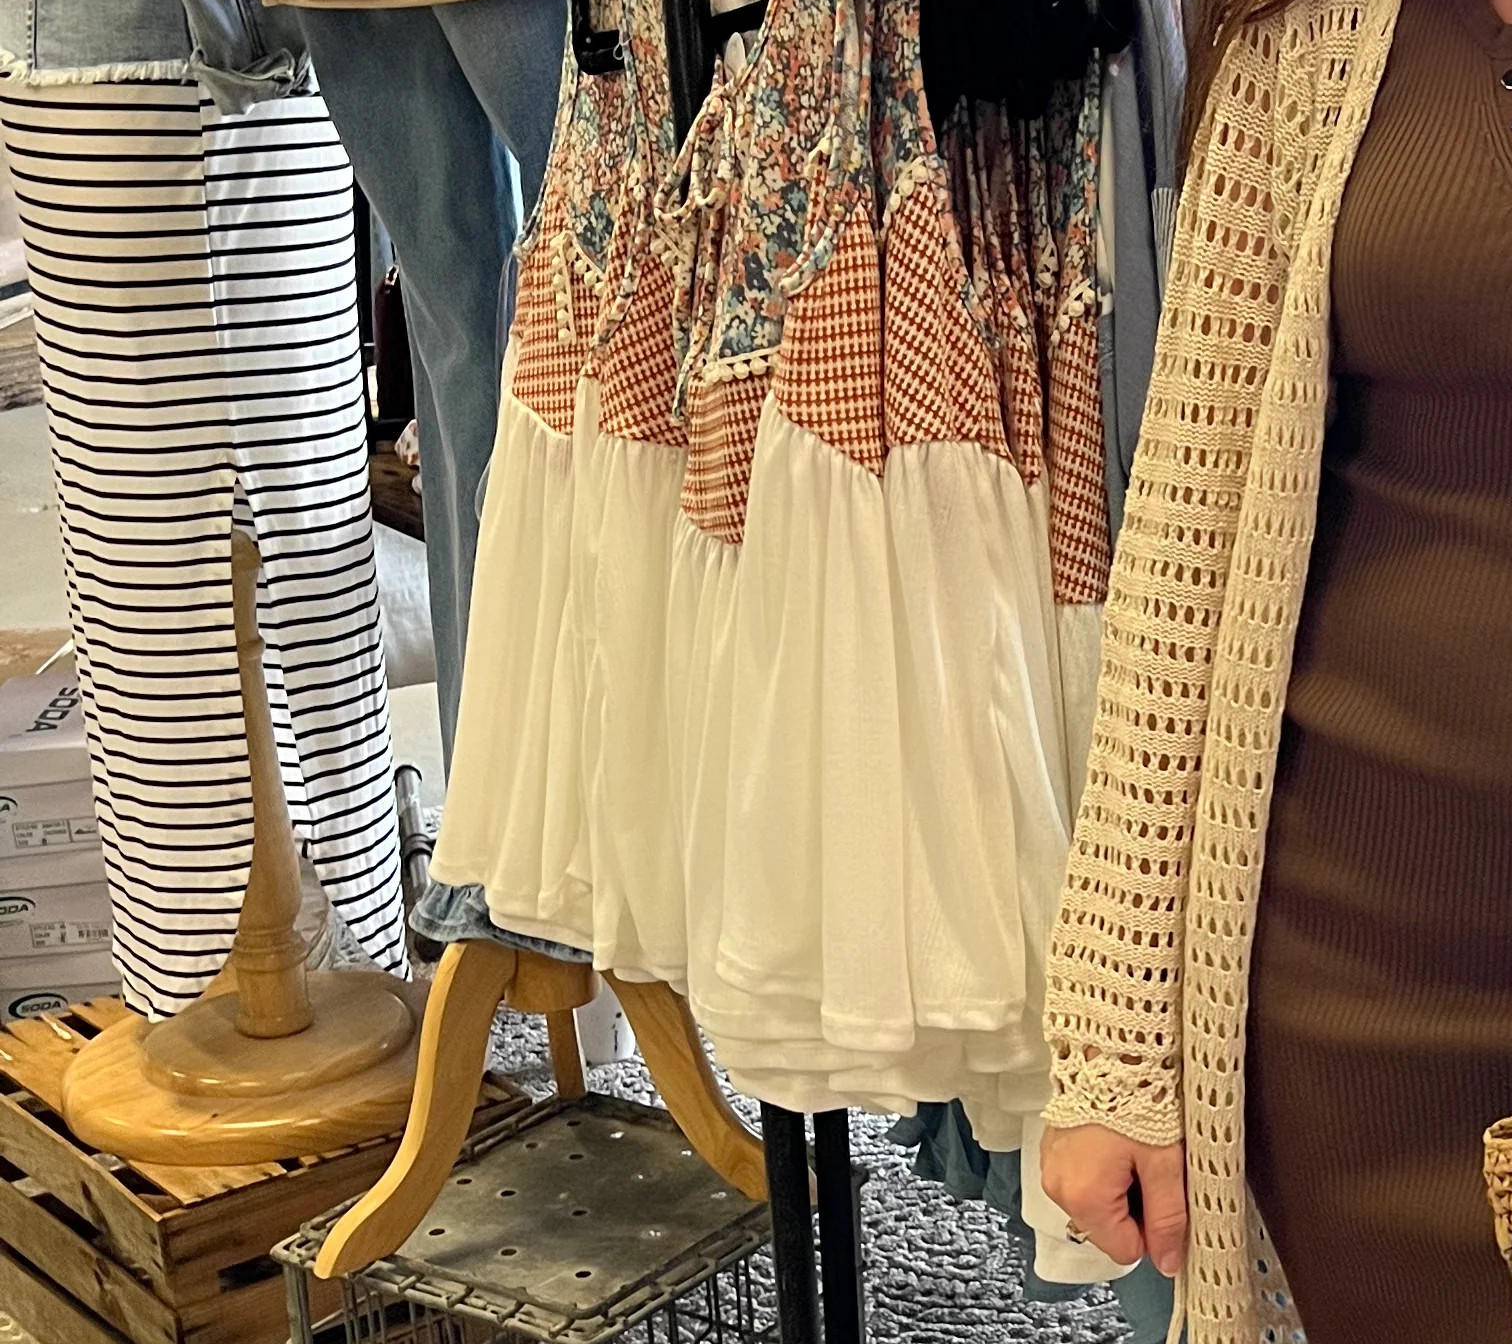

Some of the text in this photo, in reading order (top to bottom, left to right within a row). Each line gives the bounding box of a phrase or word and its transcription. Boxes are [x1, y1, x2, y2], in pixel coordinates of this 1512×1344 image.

[26, 687, 79, 733] SODA
[0, 904, 28, 915] ODA
[21, 1001, 61, 1013] SODA
